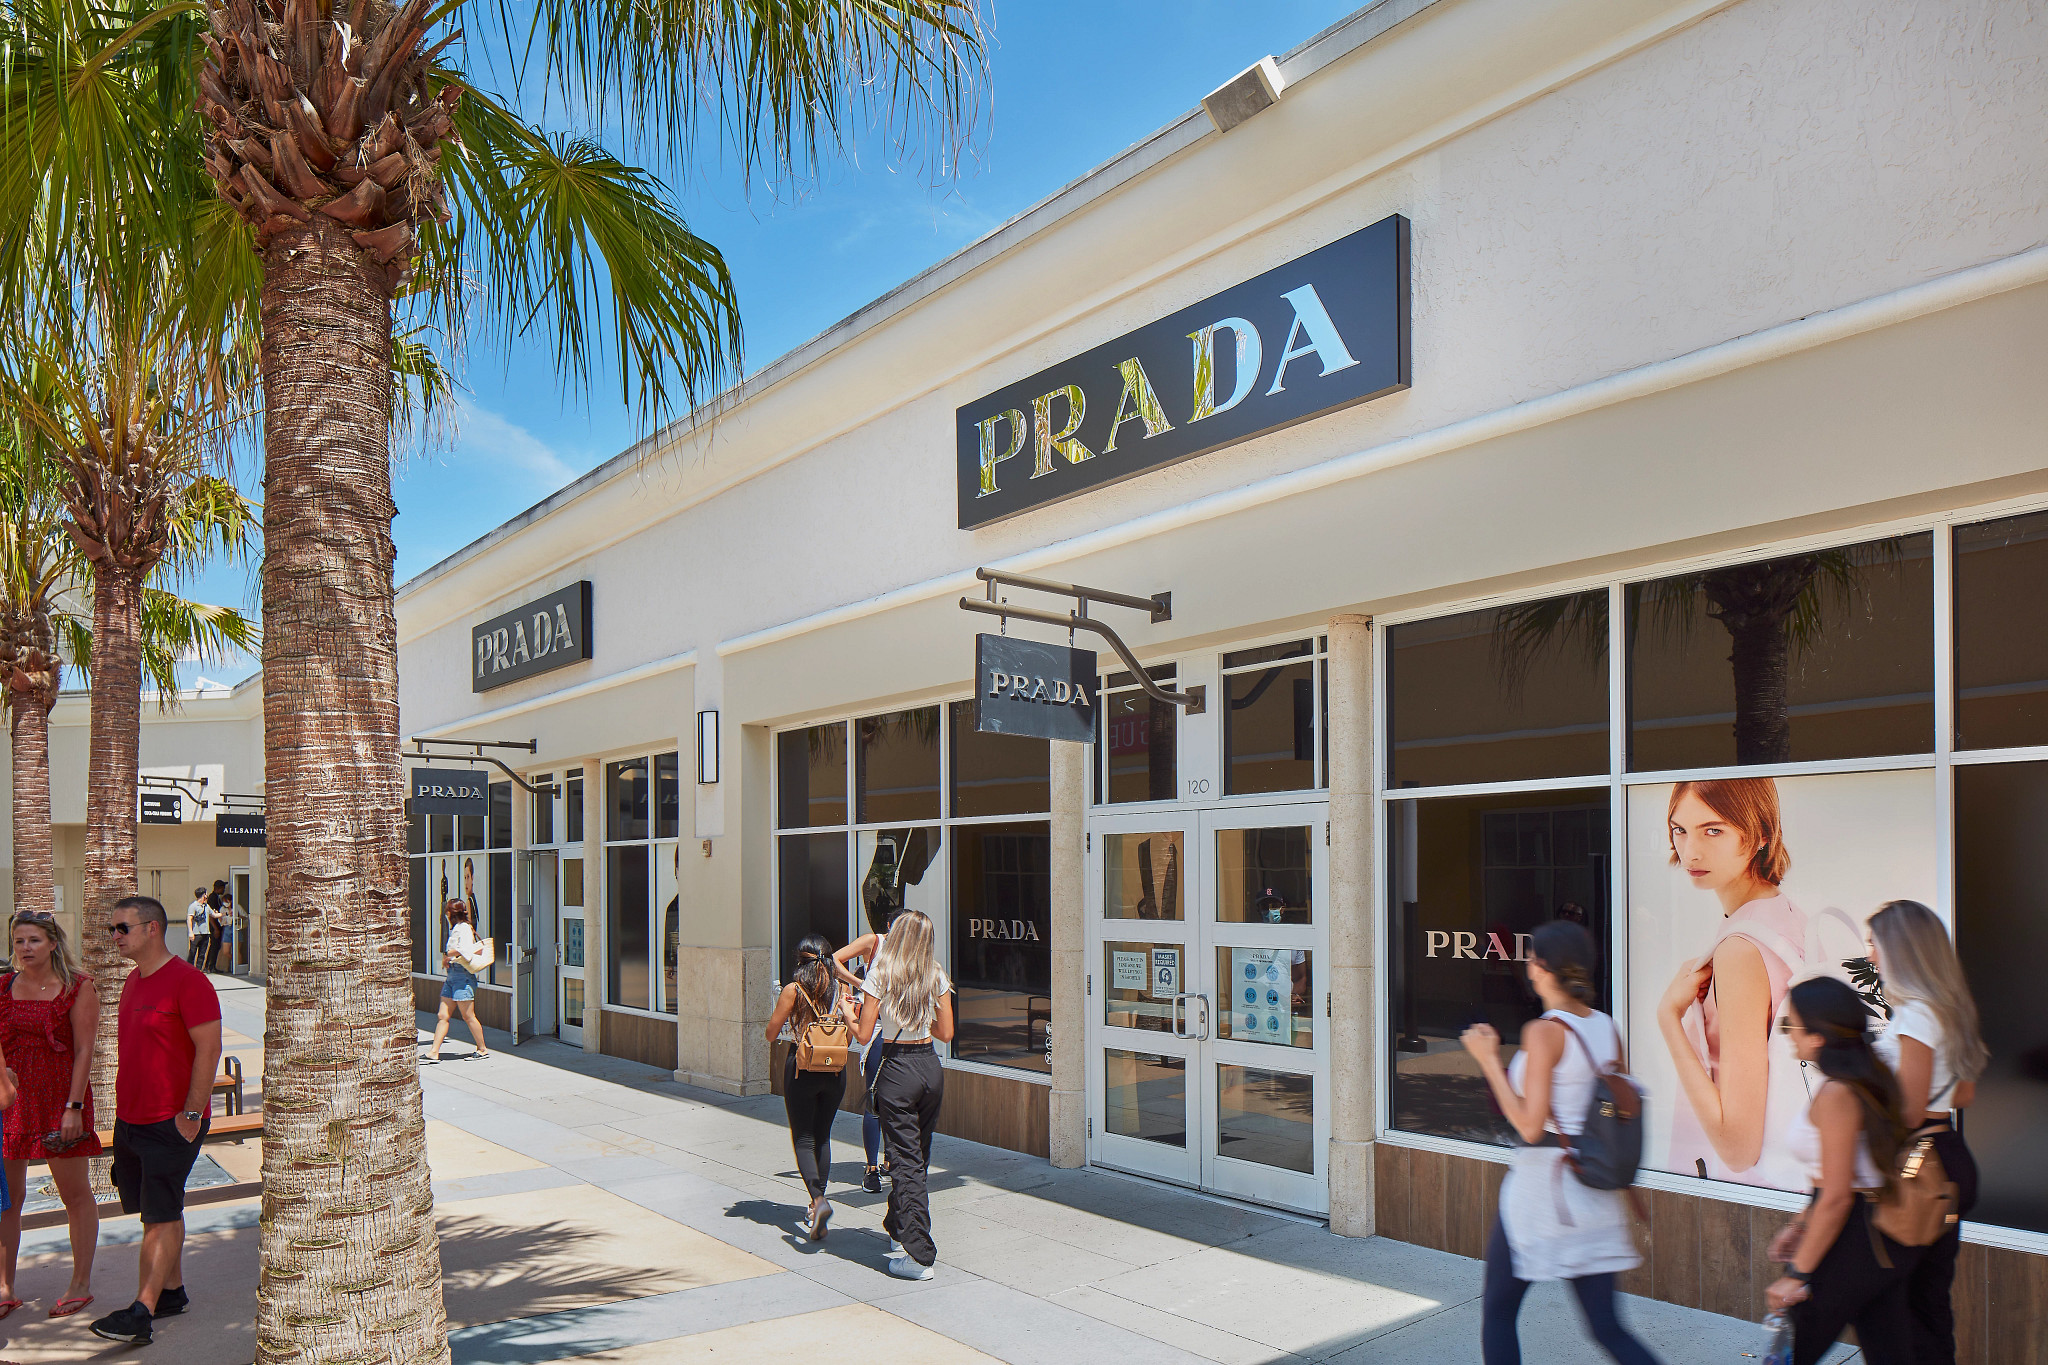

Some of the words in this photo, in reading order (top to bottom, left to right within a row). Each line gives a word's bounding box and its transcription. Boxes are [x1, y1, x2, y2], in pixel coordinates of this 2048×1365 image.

[974, 283, 1361, 499] PRADA
[477, 603, 575, 679] PRADA
[989, 672, 1090, 707] PRADA
[417, 785, 484, 799] PRADA
[1188, 779, 1210, 794] 120
[969, 918, 1040, 941] PRADA
[1425, 930, 1536, 961] PRAD
